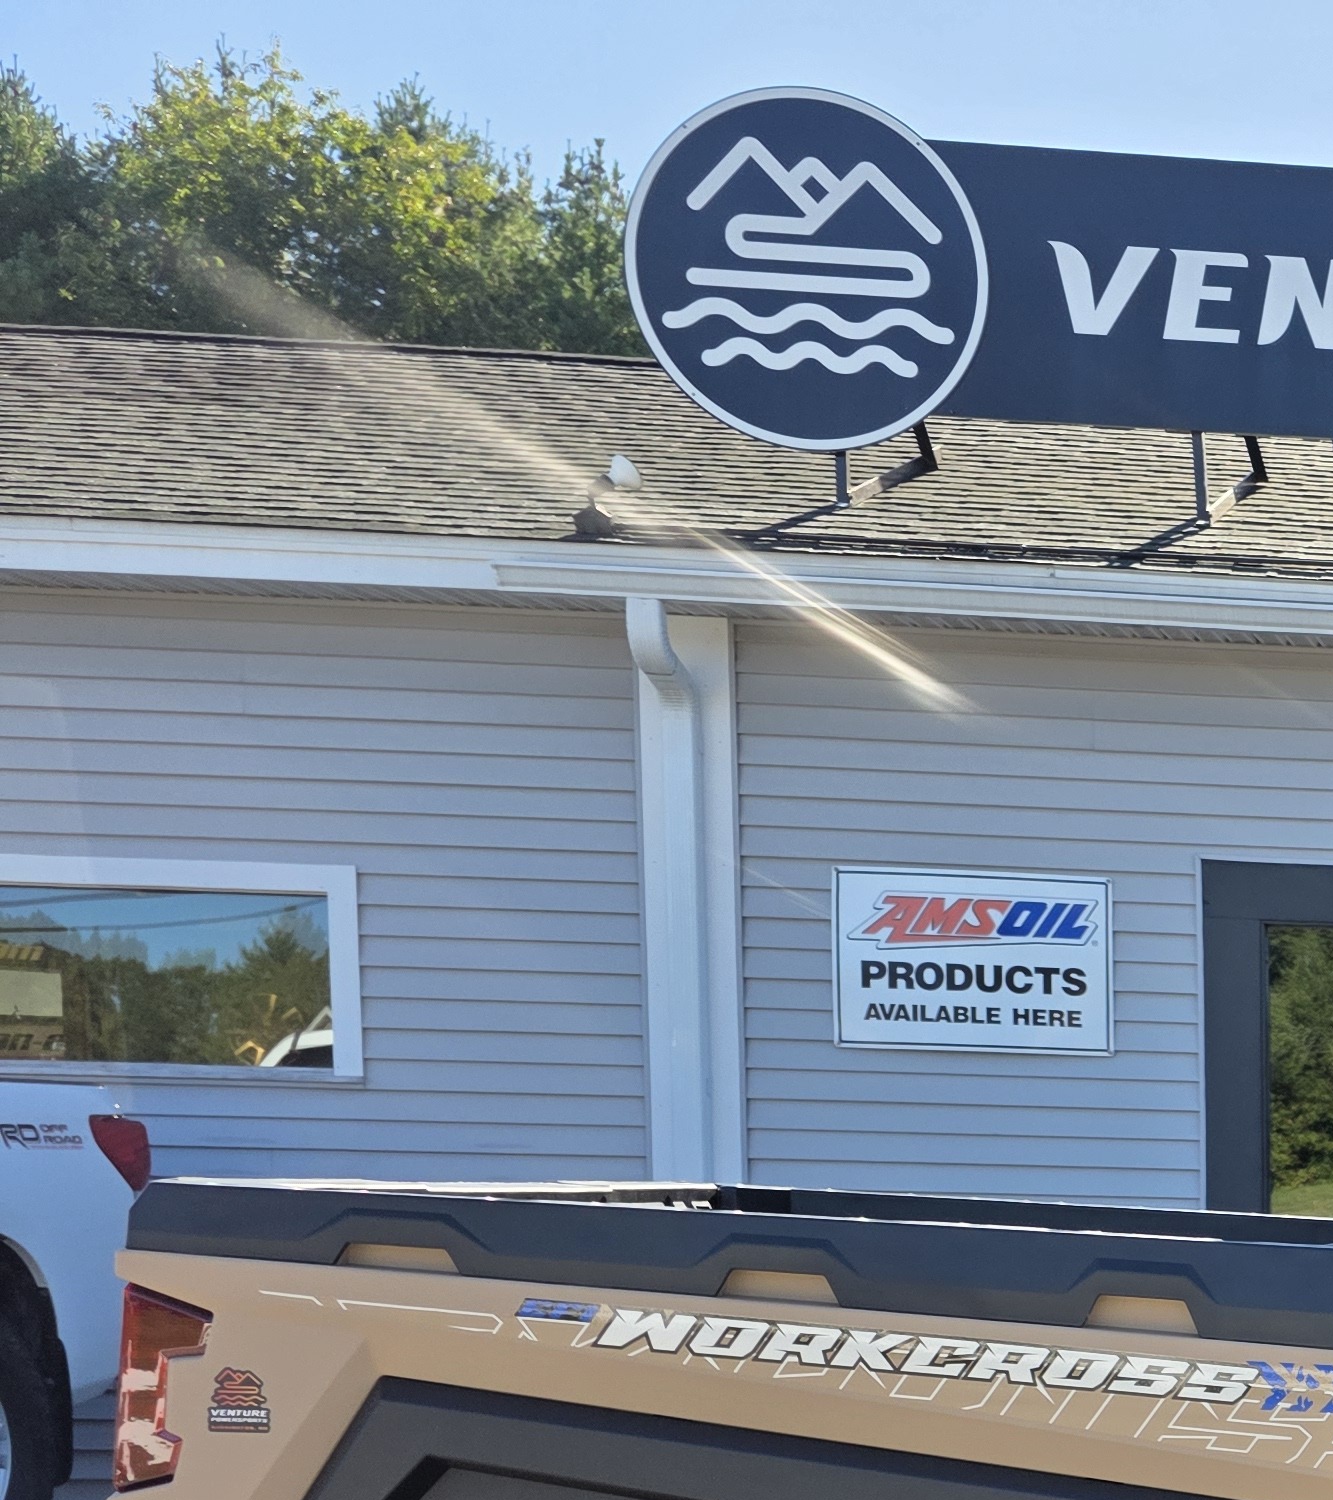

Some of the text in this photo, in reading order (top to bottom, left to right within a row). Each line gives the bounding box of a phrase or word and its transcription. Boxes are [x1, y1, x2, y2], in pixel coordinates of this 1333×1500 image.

[862, 895, 1089, 944] AMSOIL
[860, 959, 1088, 997] PRODUCTS
[864, 1003, 1083, 1028] AVAILABLE HERE
[593, 1306, 1260, 1404] WORKCROSS
[210, 1408, 268, 1418] VENTURE
